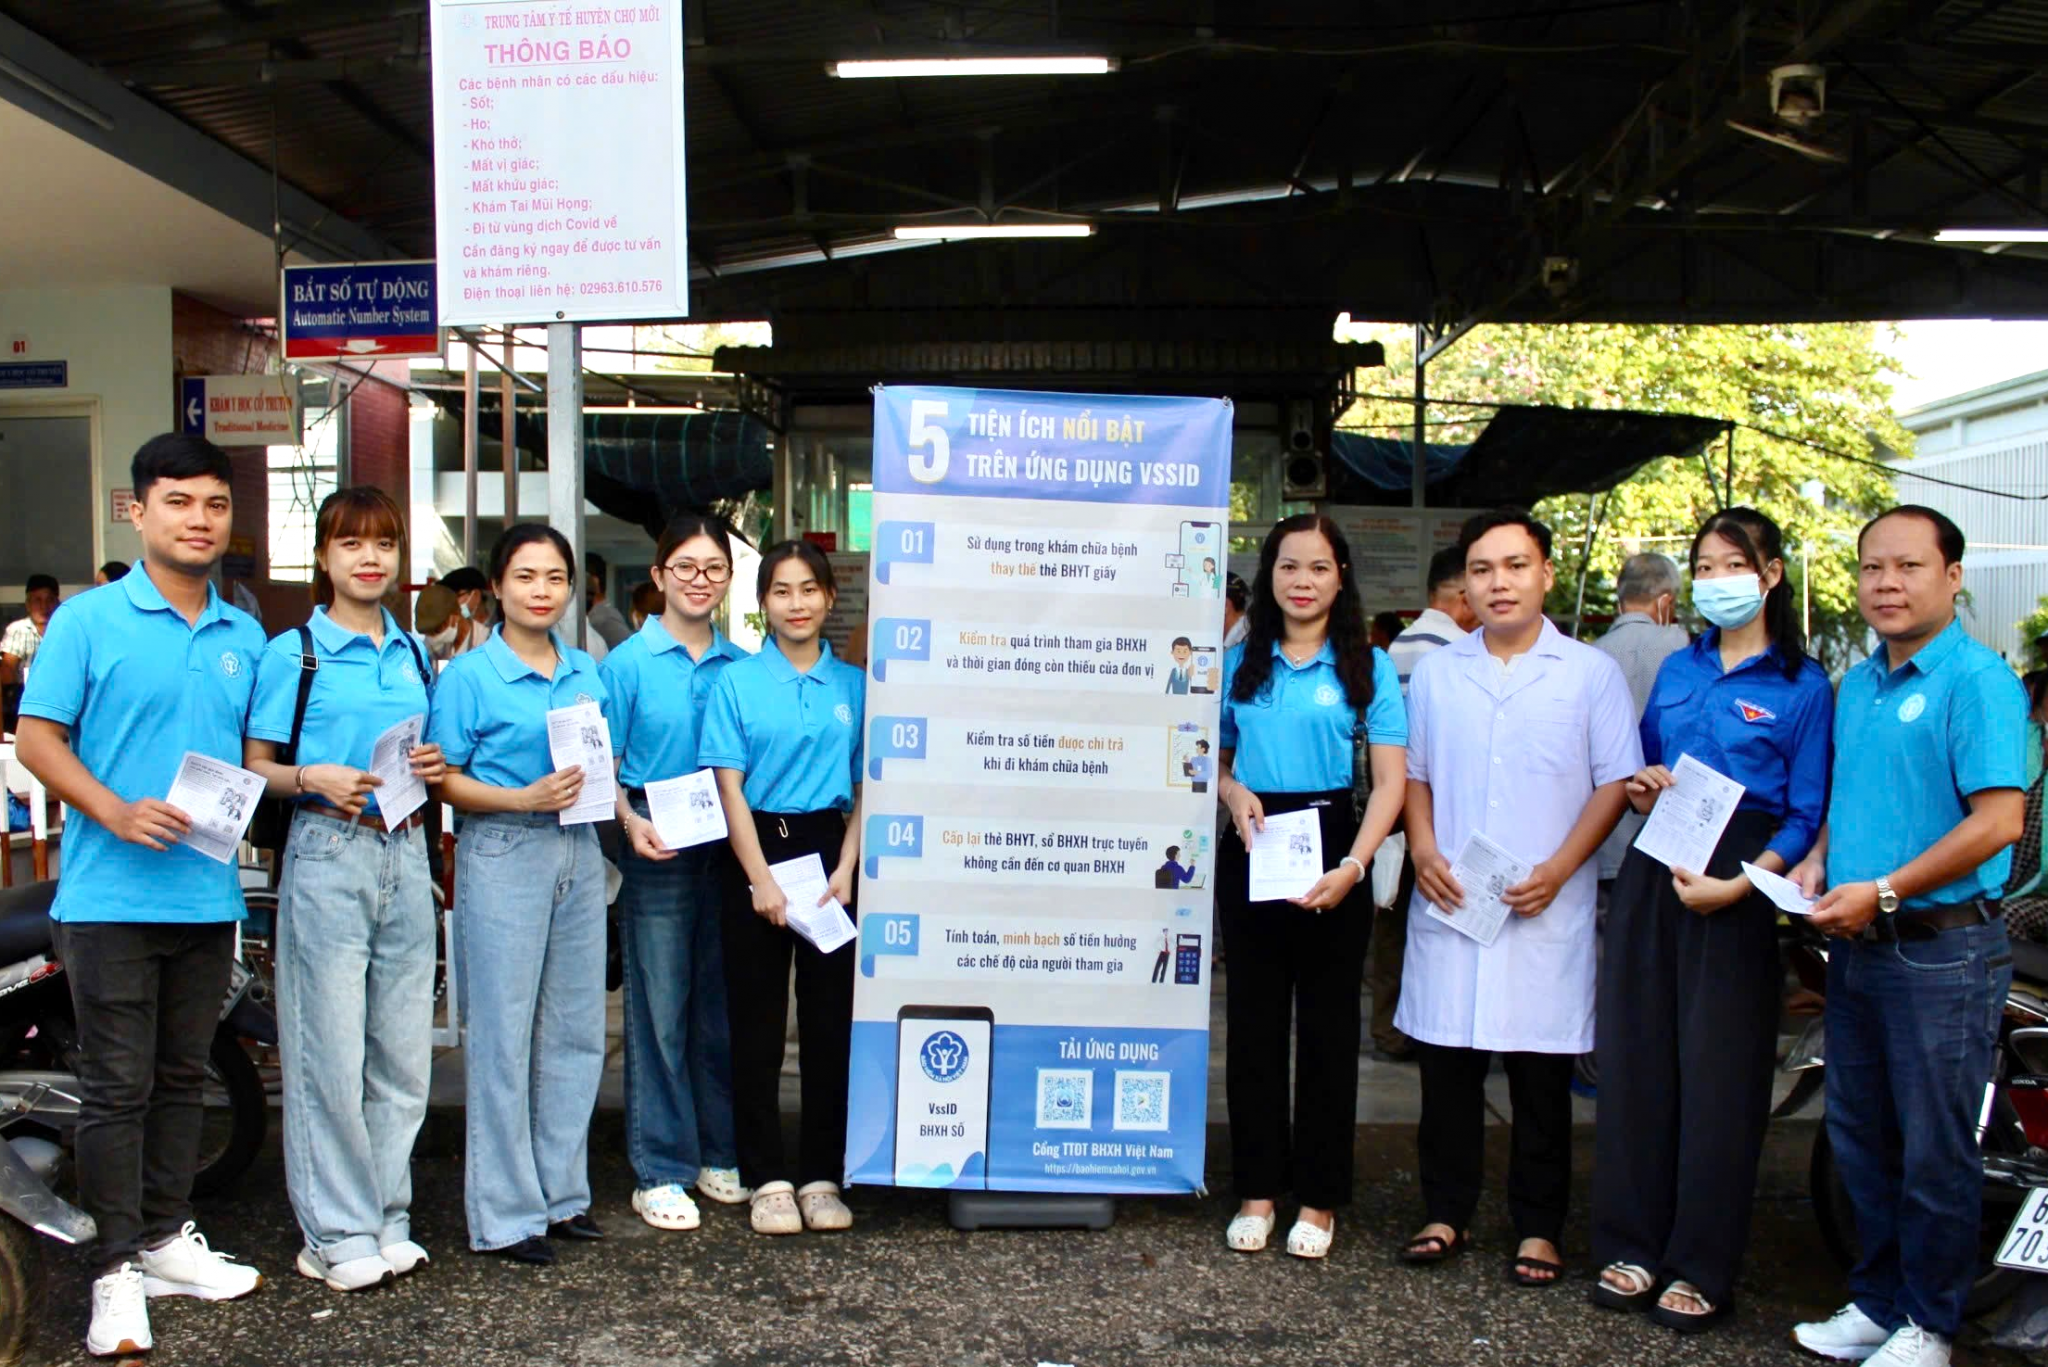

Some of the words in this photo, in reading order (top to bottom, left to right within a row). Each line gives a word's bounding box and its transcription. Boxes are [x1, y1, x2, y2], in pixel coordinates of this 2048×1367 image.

[485, 15, 519, 29] TRUNG
[524, 10, 545, 28] TÂM
[549, 12, 555, 26] Y
[560, 6, 572, 26] TẾ
[576, 7, 611, 27] HUYỆN
[615, 7, 636, 25] CHỢ
[640, 4, 659, 22] MỚI
[484, 38, 569, 63] THÔNG
[579, 34, 631, 59] BÁO
[459, 78, 482, 90] Các
[487, 76, 516, 89] bệnh
[522, 75, 551, 87] nhân
[557, 74, 570, 86] có
[576, 73, 596, 85] các
[602, 70, 624, 84] dấu
[629, 71, 658, 83] hiệu:
[470, 95, 494, 109] Sốt;
[471, 119, 490, 130] Ho;
[499, 136, 522, 149] thở;
[472, 157, 493, 171] Mất
[497, 159, 507, 173] vị
[511, 157, 539, 173] giác;
[473, 178, 494, 192] Mất
[497, 178, 526, 192] khứu
[530, 178, 559, 193] giác;
[473, 201, 506, 213] Khám
[511, 200, 528, 212] Tai
[532, 198, 553, 211] Mũi
[557, 198, 592, 211] Họng;
[473, 222, 485, 234] Đi
[489, 221, 500, 233] từ
[504, 221, 533, 235] vùng
[537, 220, 562, 232] dịch
[566, 217, 599, 230] Covid
[604, 215, 617, 228] về
[490, 244, 520, 259] đăng
[524, 242, 537, 258] ký
[541, 243, 569, 256] ngay
[574, 238, 587, 253] để
[592, 240, 621, 253] được
[625, 238, 636, 250] tư
[640, 235, 661, 250] vấn
[463, 267, 477, 278] và
[481, 265, 512, 277] khám
[517, 265, 550, 278] riêng.
[294, 275, 325, 302] BẮT
[330, 274, 352, 301] SỐ
[356, 278, 378, 304] TỰ
[382, 276, 429, 303] ĐỘNG
[464, 286, 490, 301] Điện
[496, 285, 525, 300] thoại
[530, 284, 551, 297] liên
[557, 283, 575, 296] hệ:
[580, 280, 662, 294] 02963.610.576
[293, 309, 346, 326] Automatic
[349, 306, 390, 324] Number
[392, 305, 430, 327] System
[13, 341, 25, 353] 01
[215, 421, 254, 433] Traditional
[257, 420, 288, 431] Medicine
[968, 410, 1011, 443] TIỆN
[1019, 409, 1055, 439] ÍCH
[1063, 409, 1098, 441] NỔI
[1106, 414, 1145, 449] BẬT
[908, 399, 950, 483] 5
[966, 451, 1017, 479] TRÊN
[1025, 451, 1067, 482] ỨNG
[1075, 459, 1133, 488] DỤNG
[1140, 463, 1200, 487] VSSID
[901, 528, 924, 554] 01
[967, 536, 981, 550] Sử
[985, 538, 1011, 555] dụng
[1015, 540, 1045, 555] trong
[1048, 540, 1078, 554] khám
[1081, 540, 1108, 555] chữa
[1111, 542, 1137, 558] bệnh
[991, 561, 1014, 577] thay
[1018, 562, 1036, 576] thế
[1040, 563, 1057, 577] thẻ
[1061, 564, 1090, 579] BHYT
[1093, 563, 1116, 581] giấy
[896, 626, 922, 650] 02
[959, 630, 987, 646] Kiểm
[991, 633, 1006, 646] tra
[1010, 634, 1031, 649] quá
[1034, 634, 1061, 648] trình
[1064, 636, 1092, 650] tham
[1095, 637, 1112, 653] gia
[1116, 637, 1147, 652] BHXH
[947, 656, 959, 669] và
[962, 656, 984, 670] thời
[987, 658, 1011, 673] gian
[1014, 657, 1041, 674] đóng
[1044, 659, 1064, 672] còn
[1068, 658, 1096, 674] thiếu
[1099, 661, 1118, 675] của
[1121, 661, 1142, 675] đơn
[1145, 662, 1155, 678] vị
[892, 724, 919, 748] 03
[966, 730, 995, 746] Kiểm
[998, 734, 1014, 747] tra
[1017, 730, 1030, 747] số
[1033, 731, 1055, 748] tiền
[1058, 735, 1085, 753] được
[1089, 737, 1105, 750] chi
[1108, 737, 1124, 751] trả
[984, 757, 1001, 770] khi
[1005, 757, 1015, 771] đi
[1019, 758, 1048, 772] khám
[1052, 759, 1079, 773] chữa
[1082, 760, 1108, 776] bệnh
[888, 822, 915, 847] 04
[943, 830, 963, 846] Cấp
[967, 831, 981, 847] lại
[984, 831, 1002, 845] thẻ
[1006, 832, 1038, 849] BHYT,
[1041, 831, 1054, 848] sổ
[1057, 834, 1088, 849] BHXH
[1092, 836, 1115, 851] trực
[1118, 835, 1148, 852] tuyến
[964, 856, 998, 873] không
[1001, 856, 1021, 871] cần
[1025, 856, 1045, 872] đến
[1048, 859, 1061, 872] cơ
[1064, 861, 1090, 875] quan
[1093, 860, 1124, 874] BHXH
[884, 920, 911, 945] 05
[945, 929, 969, 944] Tính
[973, 930, 1000, 947] toán,
[1003, 932, 1031, 945] minh
[1034, 932, 1060, 948] bạch
[1064, 931, 1076, 947] số
[1079, 932, 1101, 947] tiền
[1104, 934, 1137, 951] hưởng
[957, 956, 977, 969] các
[980, 953, 1000, 969] chế
[1003, 956, 1016, 972] độ
[1019, 956, 1039, 970] của
[1042, 957, 1073, 973] người
[1076, 957, 1104, 971] tham
[1107, 959, 1123, 974] gia
[1059, 1038, 1081, 1060] TẢI
[1086, 1038, 1115, 1060] ỨNG
[1120, 1042, 1159, 1064] DỤNG
[929, 1102, 957, 1116] VssID
[920, 1124, 948, 1137] BHXH
[951, 1121, 965, 1138] SỐ
[1032, 1141, 1060, 1159] Cổng
[1063, 1142, 1088, 1157] TTĐT
[1091, 1143, 1121, 1157] BHXH
[1125, 1144, 1146, 1160] Việt
[1150, 1146, 1173, 1159] Nam
[1044, 1162, 1157, 1176] https://baohiemxahoi.gov.vn
[2033, 1194, 2048, 1224] 6
